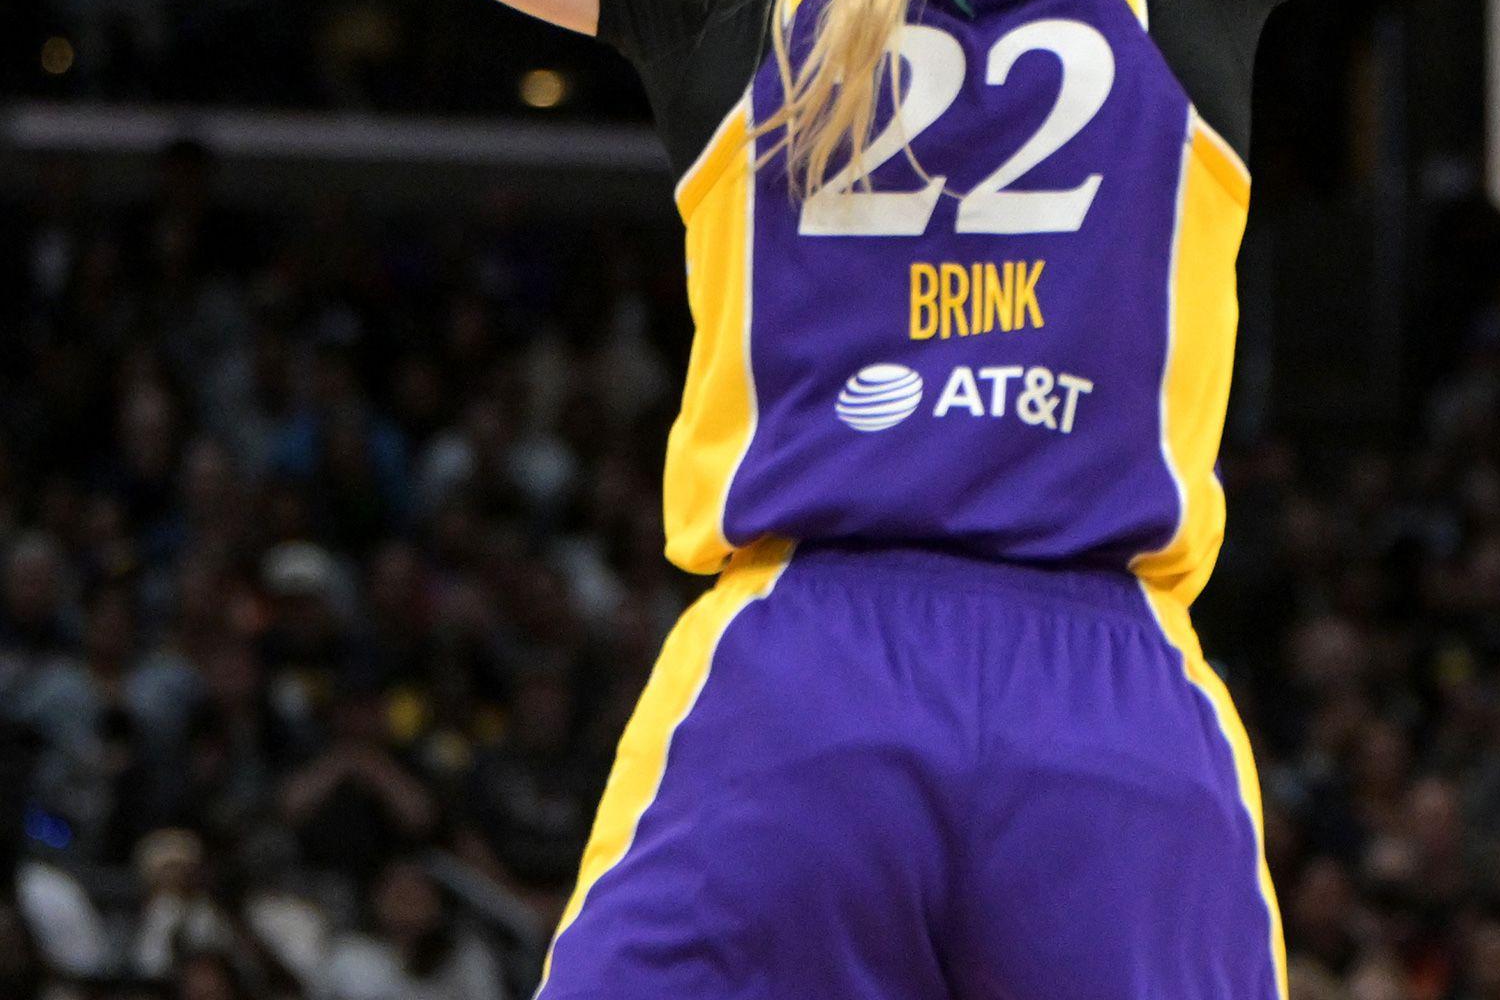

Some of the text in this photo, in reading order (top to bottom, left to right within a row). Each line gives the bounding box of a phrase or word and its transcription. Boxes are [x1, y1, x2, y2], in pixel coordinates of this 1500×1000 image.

[799, 18, 1115, 236] 22
[909, 260, 1045, 340] BRINK
[933, 366, 1093, 433] AT&T
